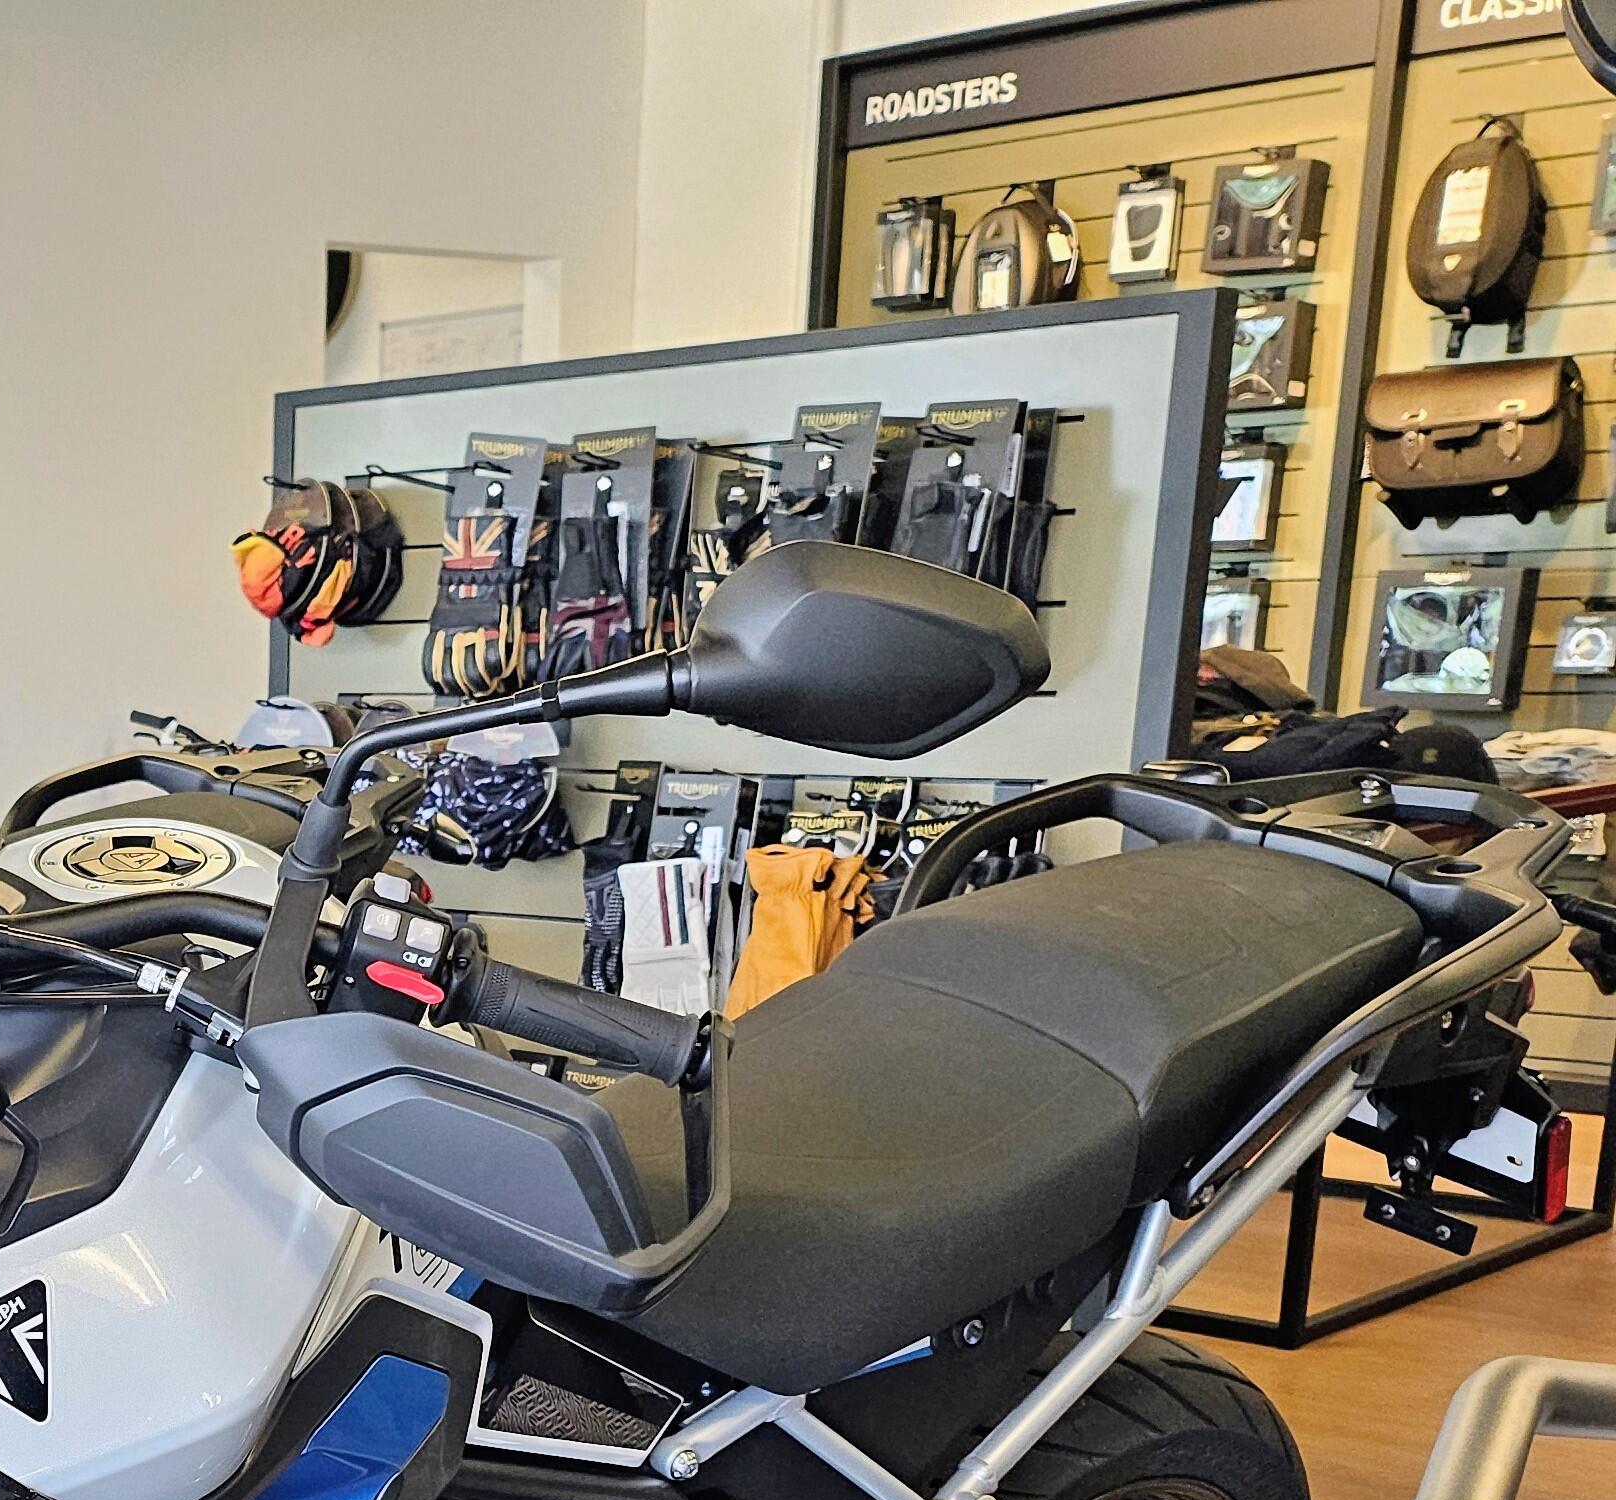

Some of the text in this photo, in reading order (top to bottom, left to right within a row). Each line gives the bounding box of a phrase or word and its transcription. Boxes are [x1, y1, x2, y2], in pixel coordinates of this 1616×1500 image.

[865, 72, 1018, 126] ROADSTERS
[801, 412, 859, 430] TRIUMPH
[931, 409, 993, 429] TRIUMPH
[472, 440, 524, 458] TRIUMPH
[576, 436, 634, 455] TRIUMPH
[667, 782, 718, 799] TRIUMPH
[790, 817, 845, 833] TRIUMPH
